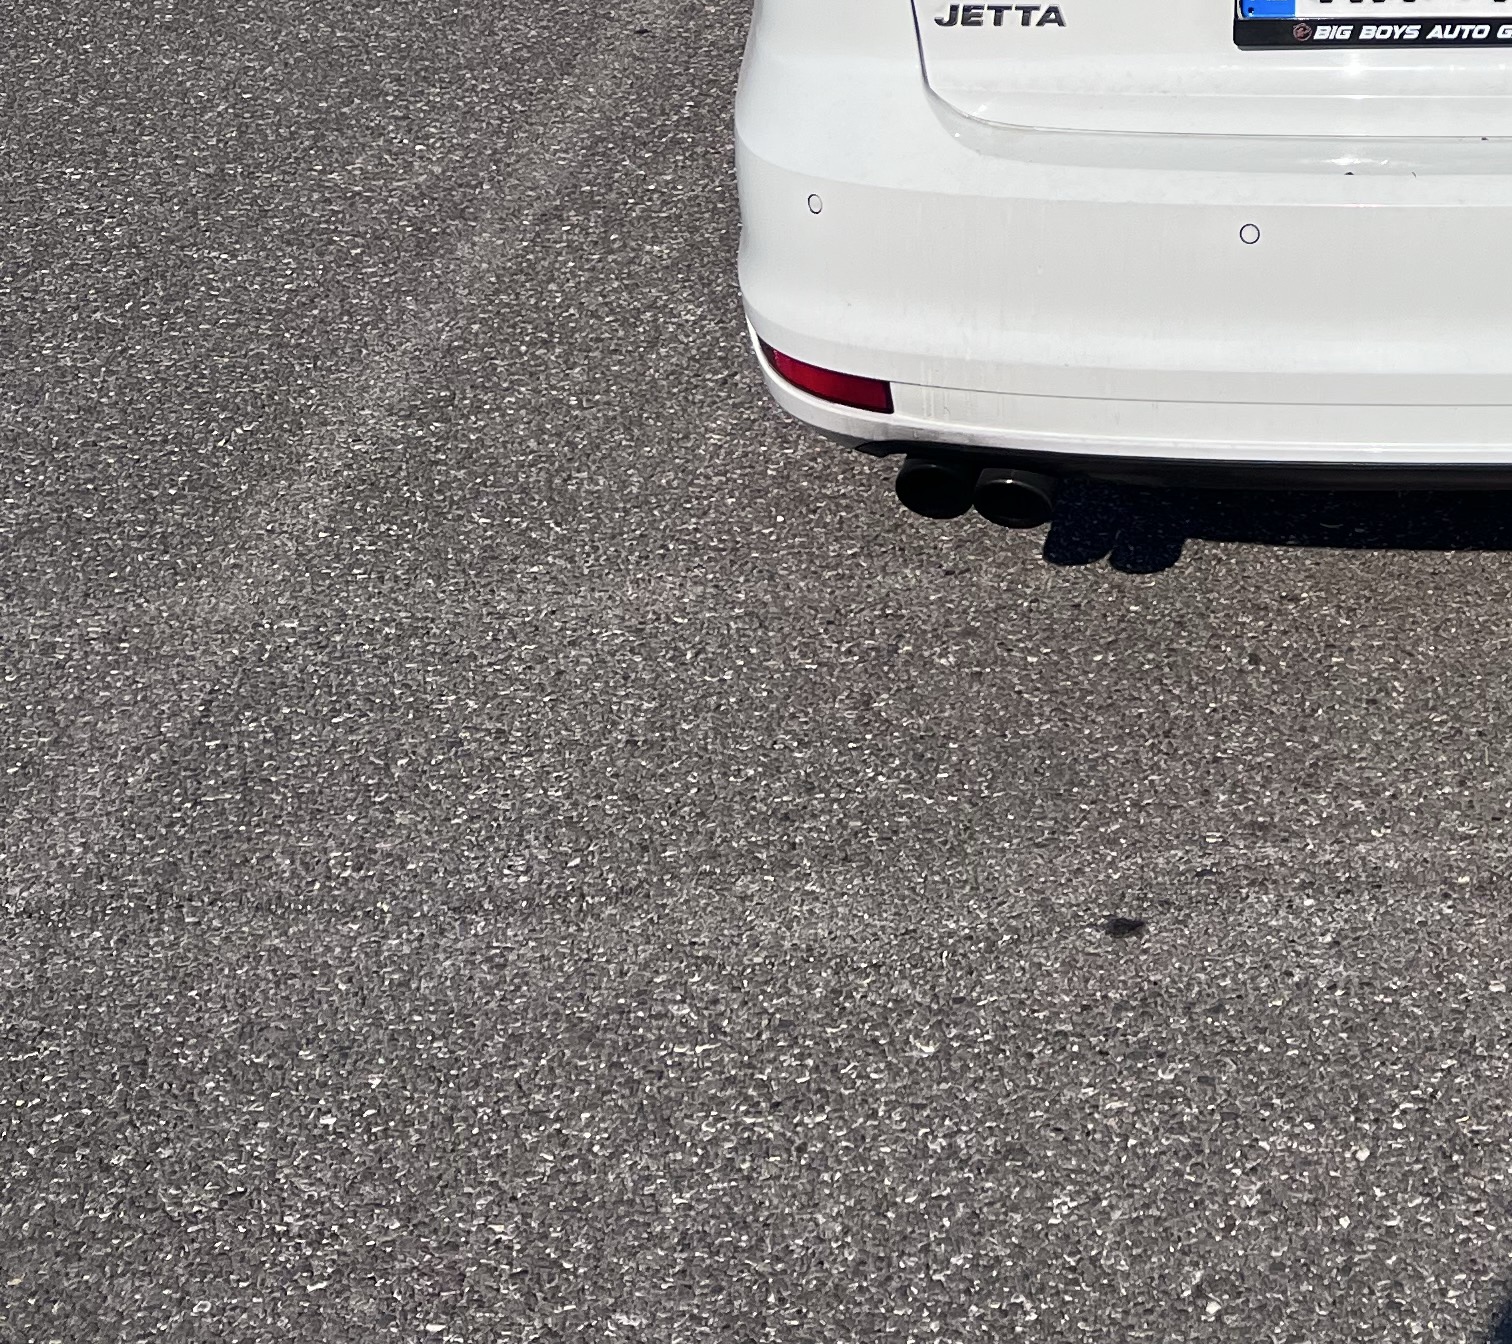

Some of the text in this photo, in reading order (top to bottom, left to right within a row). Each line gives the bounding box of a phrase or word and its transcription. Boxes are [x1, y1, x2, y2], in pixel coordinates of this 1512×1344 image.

[933, 4, 1066, 27] JETTA
[1313, 25, 1353, 40] BIG
[1358, 25, 1421, 40] BOYS
[1426, 24, 1490, 39] AUTO
